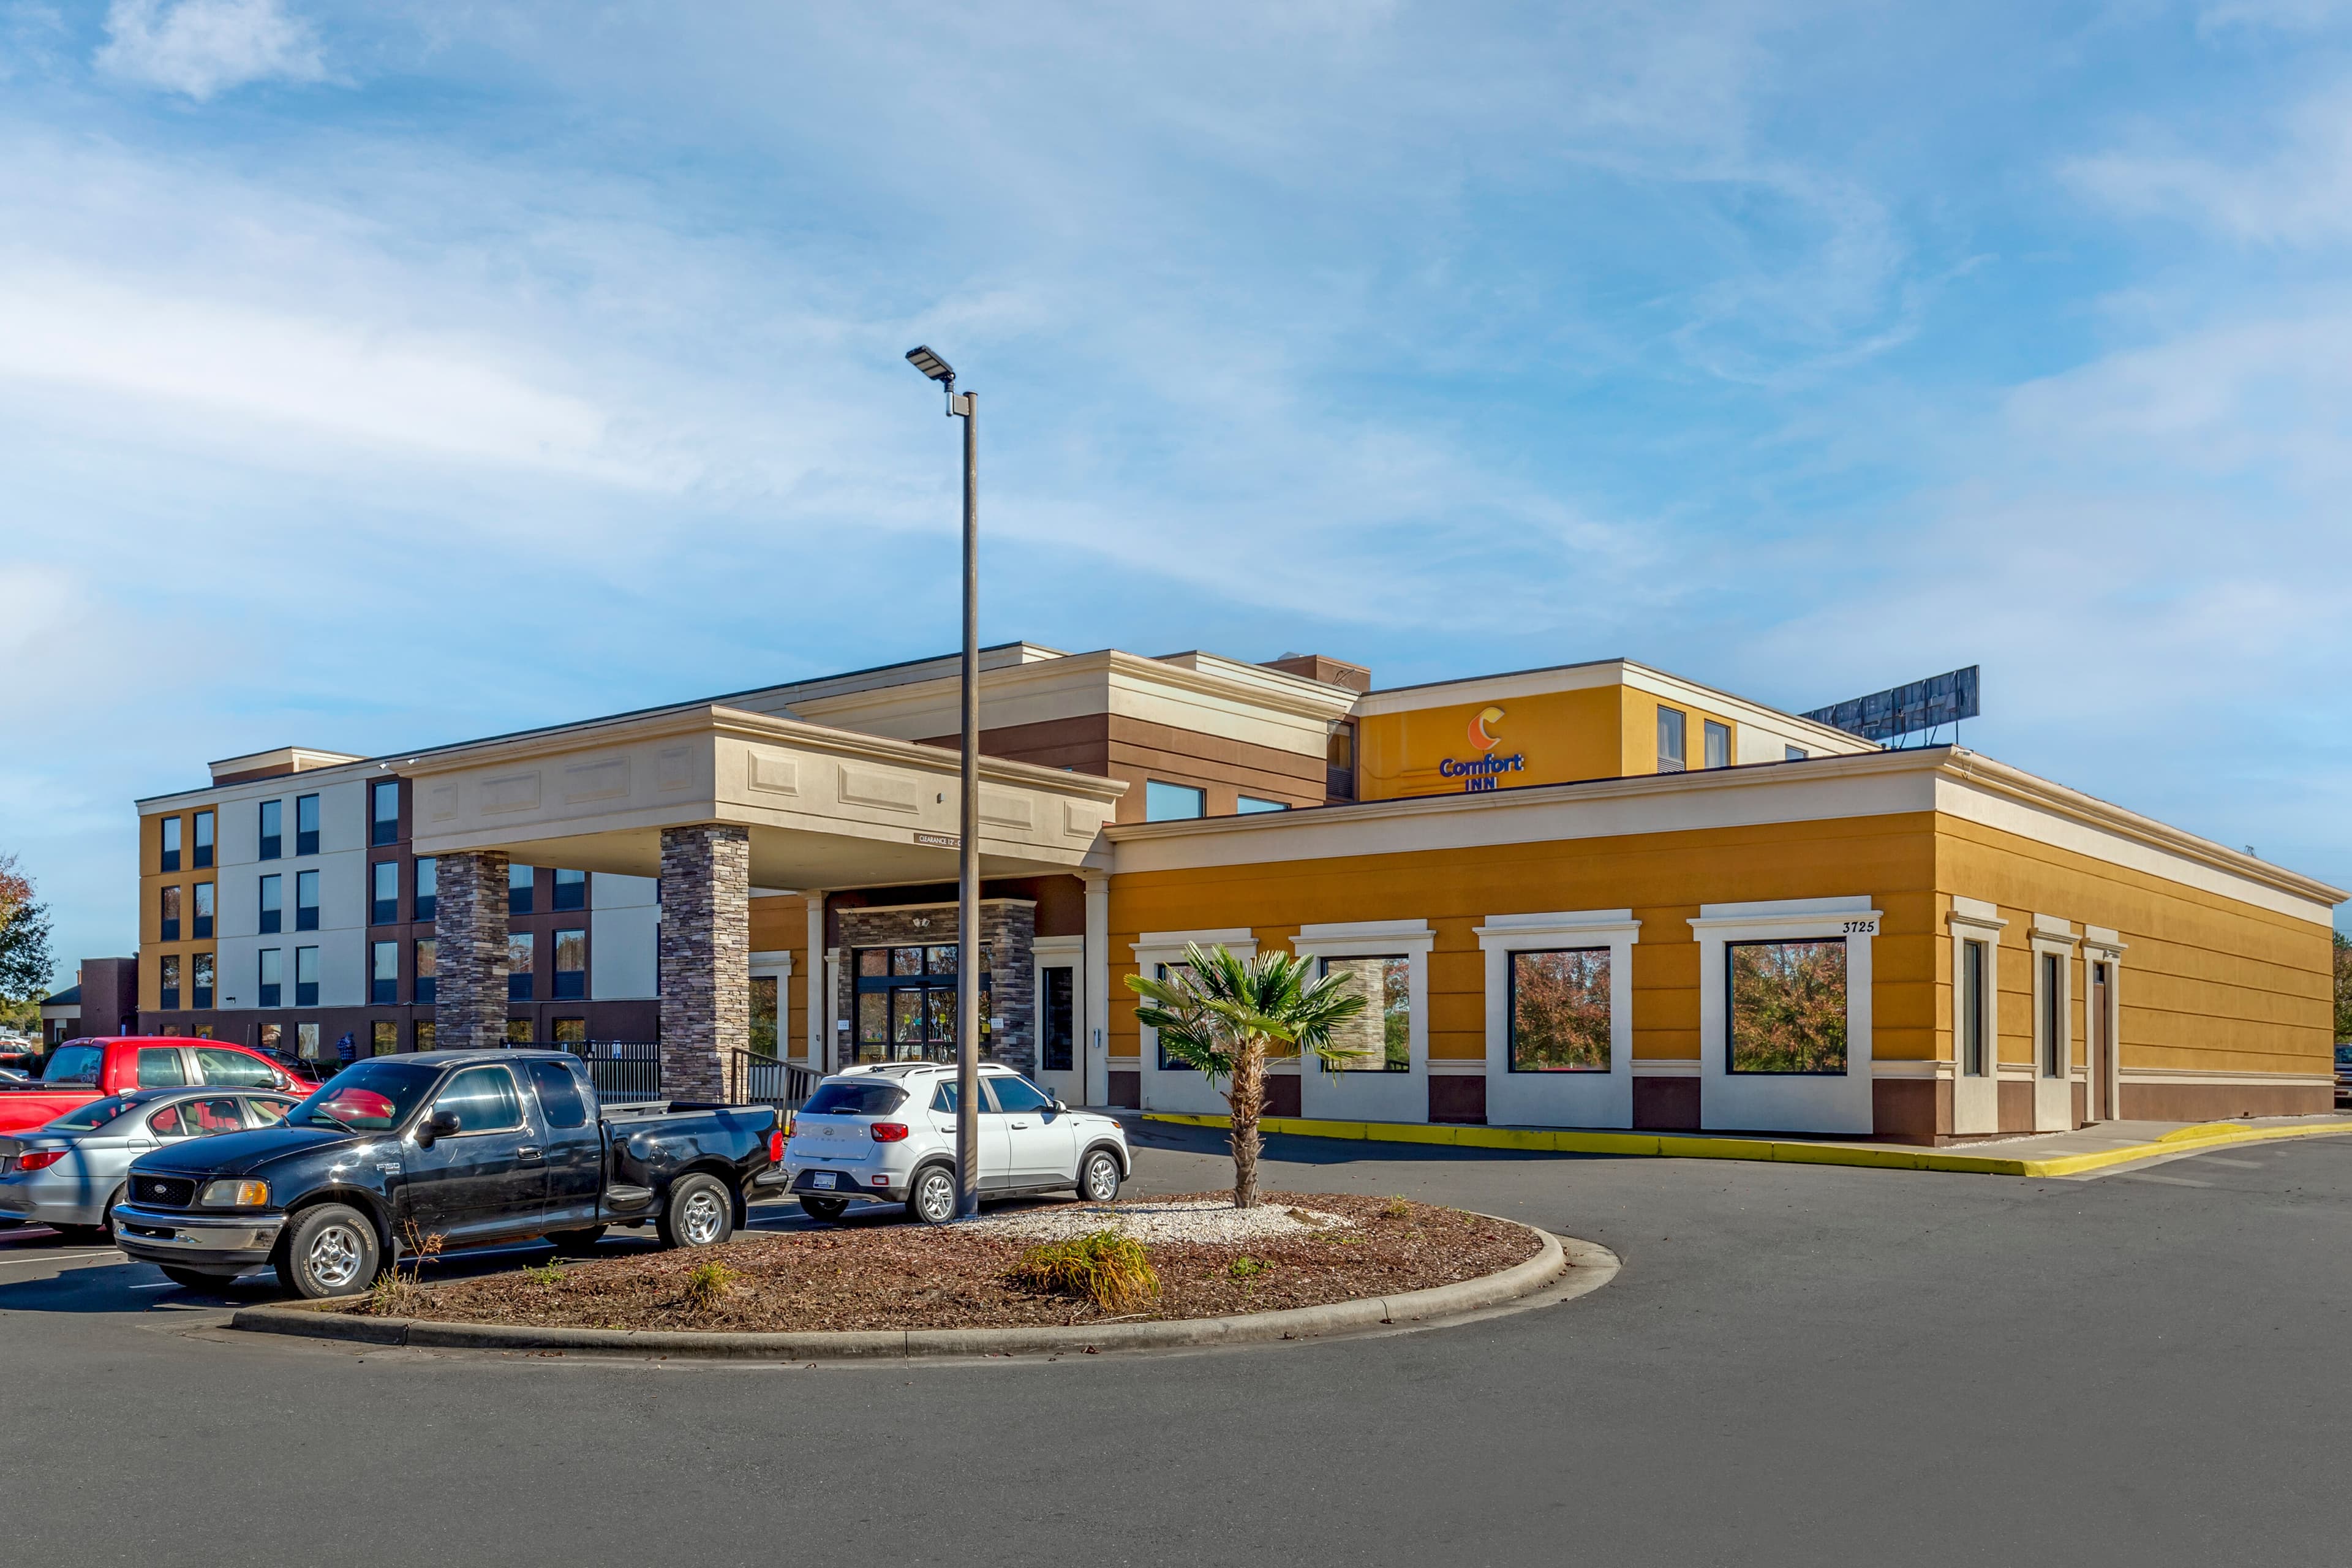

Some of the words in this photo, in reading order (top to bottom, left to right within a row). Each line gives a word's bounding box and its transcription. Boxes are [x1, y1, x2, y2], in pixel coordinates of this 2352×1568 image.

[1439, 753, 1524, 778] Comfort
[1465, 777, 1497, 791] INN
[919, 835, 947, 845] CLEARANCE
[1842, 921, 1875, 933] 3725
[347, 1218, 372, 1251] GRABBER
[303, 1258, 329, 1294] GENERAL
